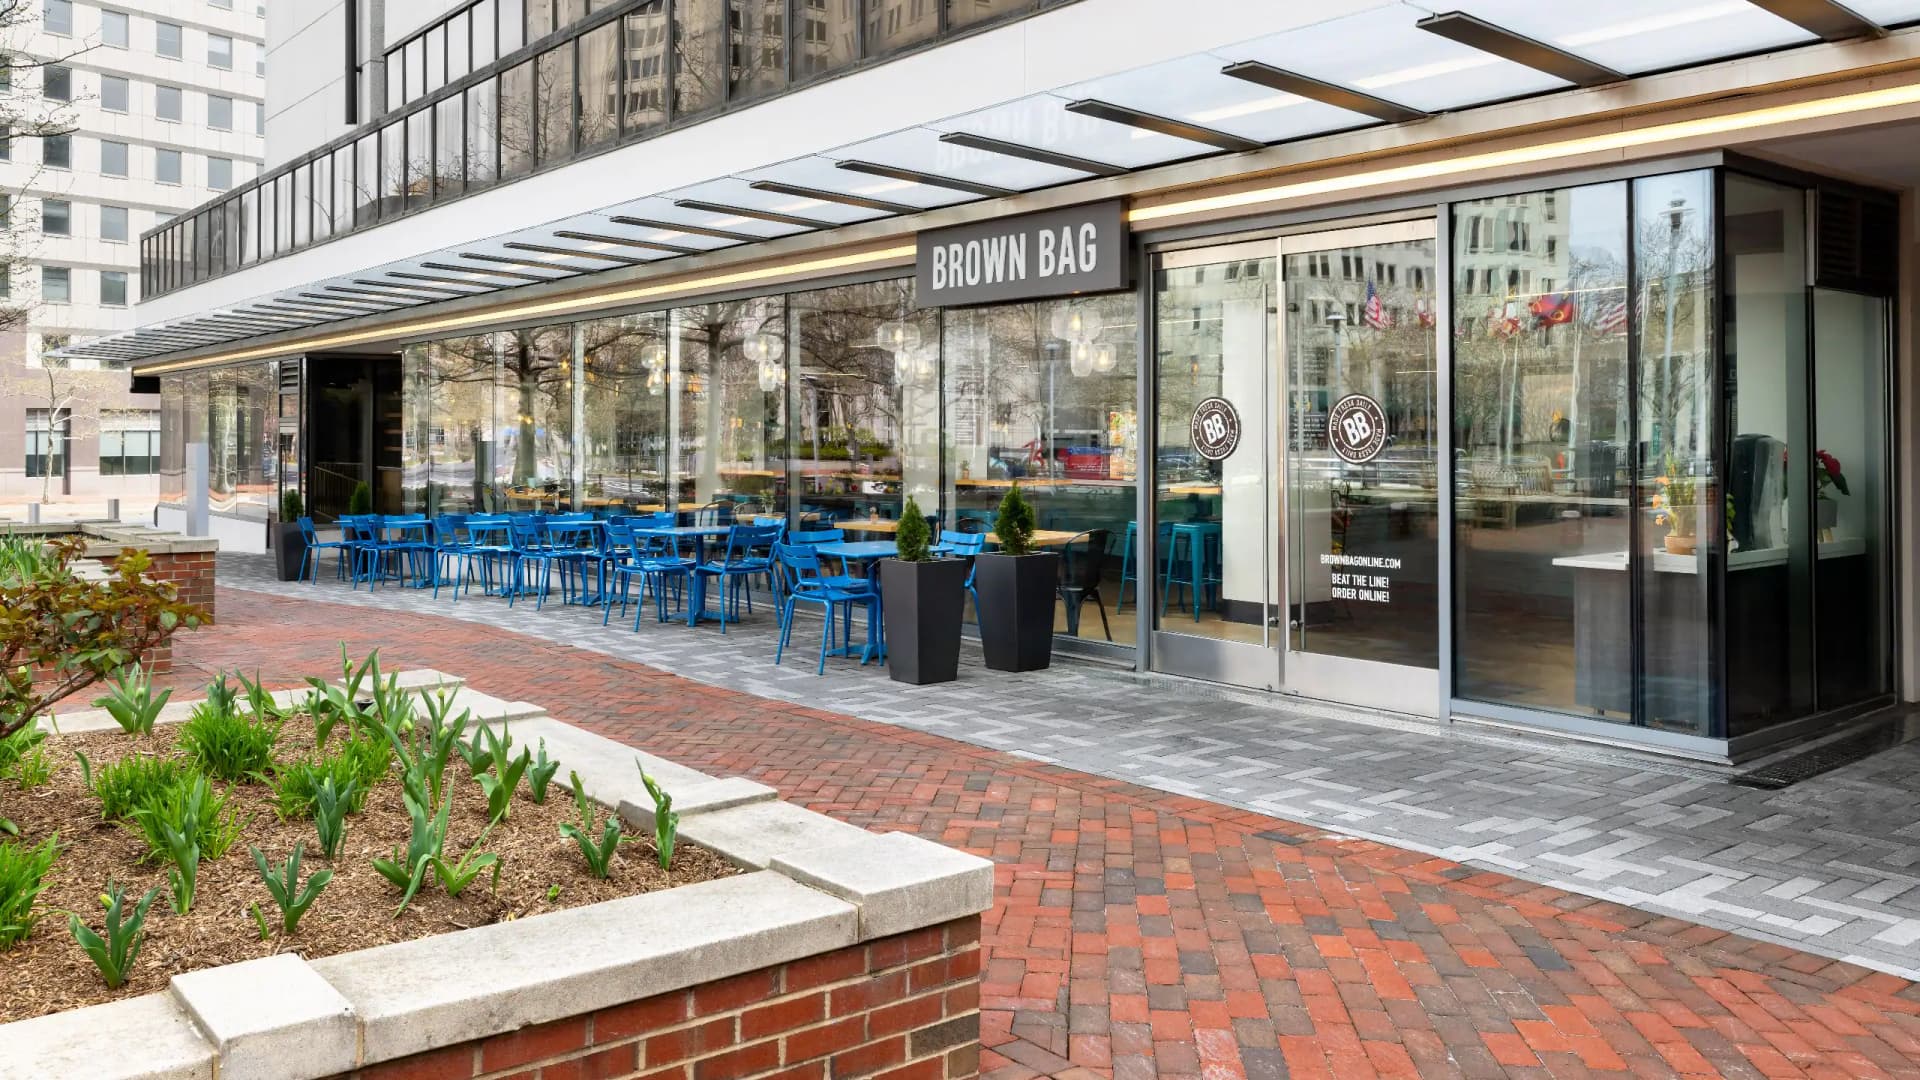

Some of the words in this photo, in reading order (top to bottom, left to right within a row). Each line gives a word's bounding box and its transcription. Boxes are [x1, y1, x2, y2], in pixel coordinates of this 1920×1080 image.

[932, 232, 1026, 290] BROWN
[1039, 222, 1097, 278] BAG
[1203, 413, 1226, 445] BB
[1342, 411, 1371, 446] BB
[1320, 554, 1401, 569] BROWNBAGONLINE.COM
[1332, 573, 1351, 585] BEAT
[1352, 574, 1367, 587] THE
[1369, 576, 1389, 588] LINE!
[1332, 587, 1357, 600] ORDER
[1359, 589, 1389, 603] ONLINE!
